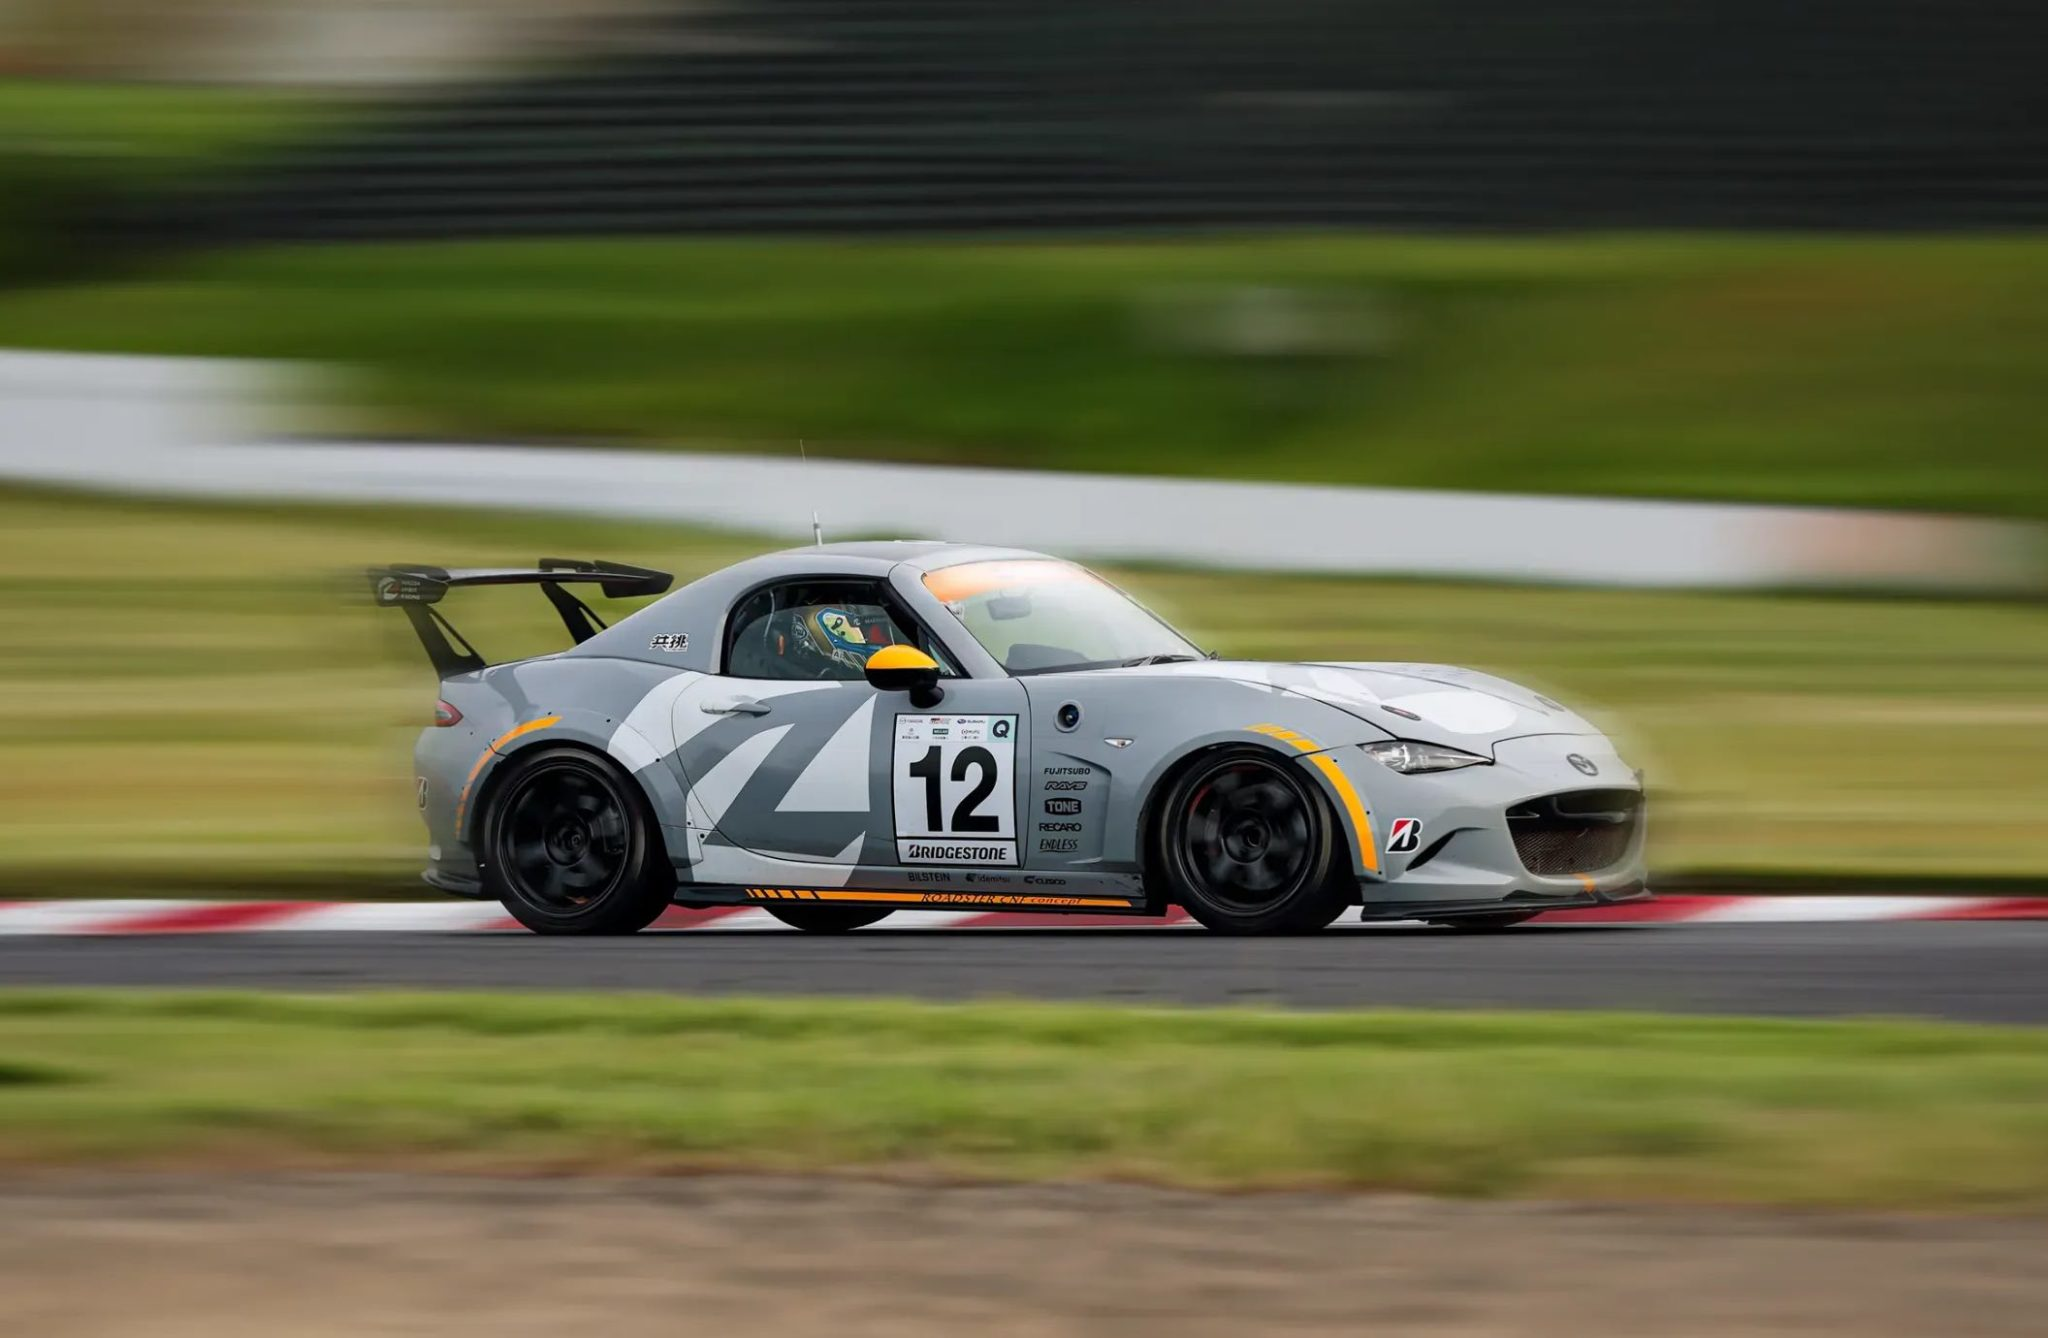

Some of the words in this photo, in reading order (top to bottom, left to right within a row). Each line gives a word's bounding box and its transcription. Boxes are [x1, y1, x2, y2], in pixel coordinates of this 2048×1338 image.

[992, 719, 1010, 738] Q
[1044, 767, 1091, 775] FUJITSUBO
[909, 745, 1000, 832] 12
[1044, 781, 1088, 791] RAYS
[1047, 800, 1079, 813] TONE
[1039, 823, 1082, 832] RECARO
[1040, 838, 1078, 850] ENDLESS
[908, 844, 1008, 860] BRIDGESTONE
[907, 871, 951, 882] BILSTEIN
[920, 892, 994, 904] ROADSTER
[1031, 897, 1082, 906] concept
